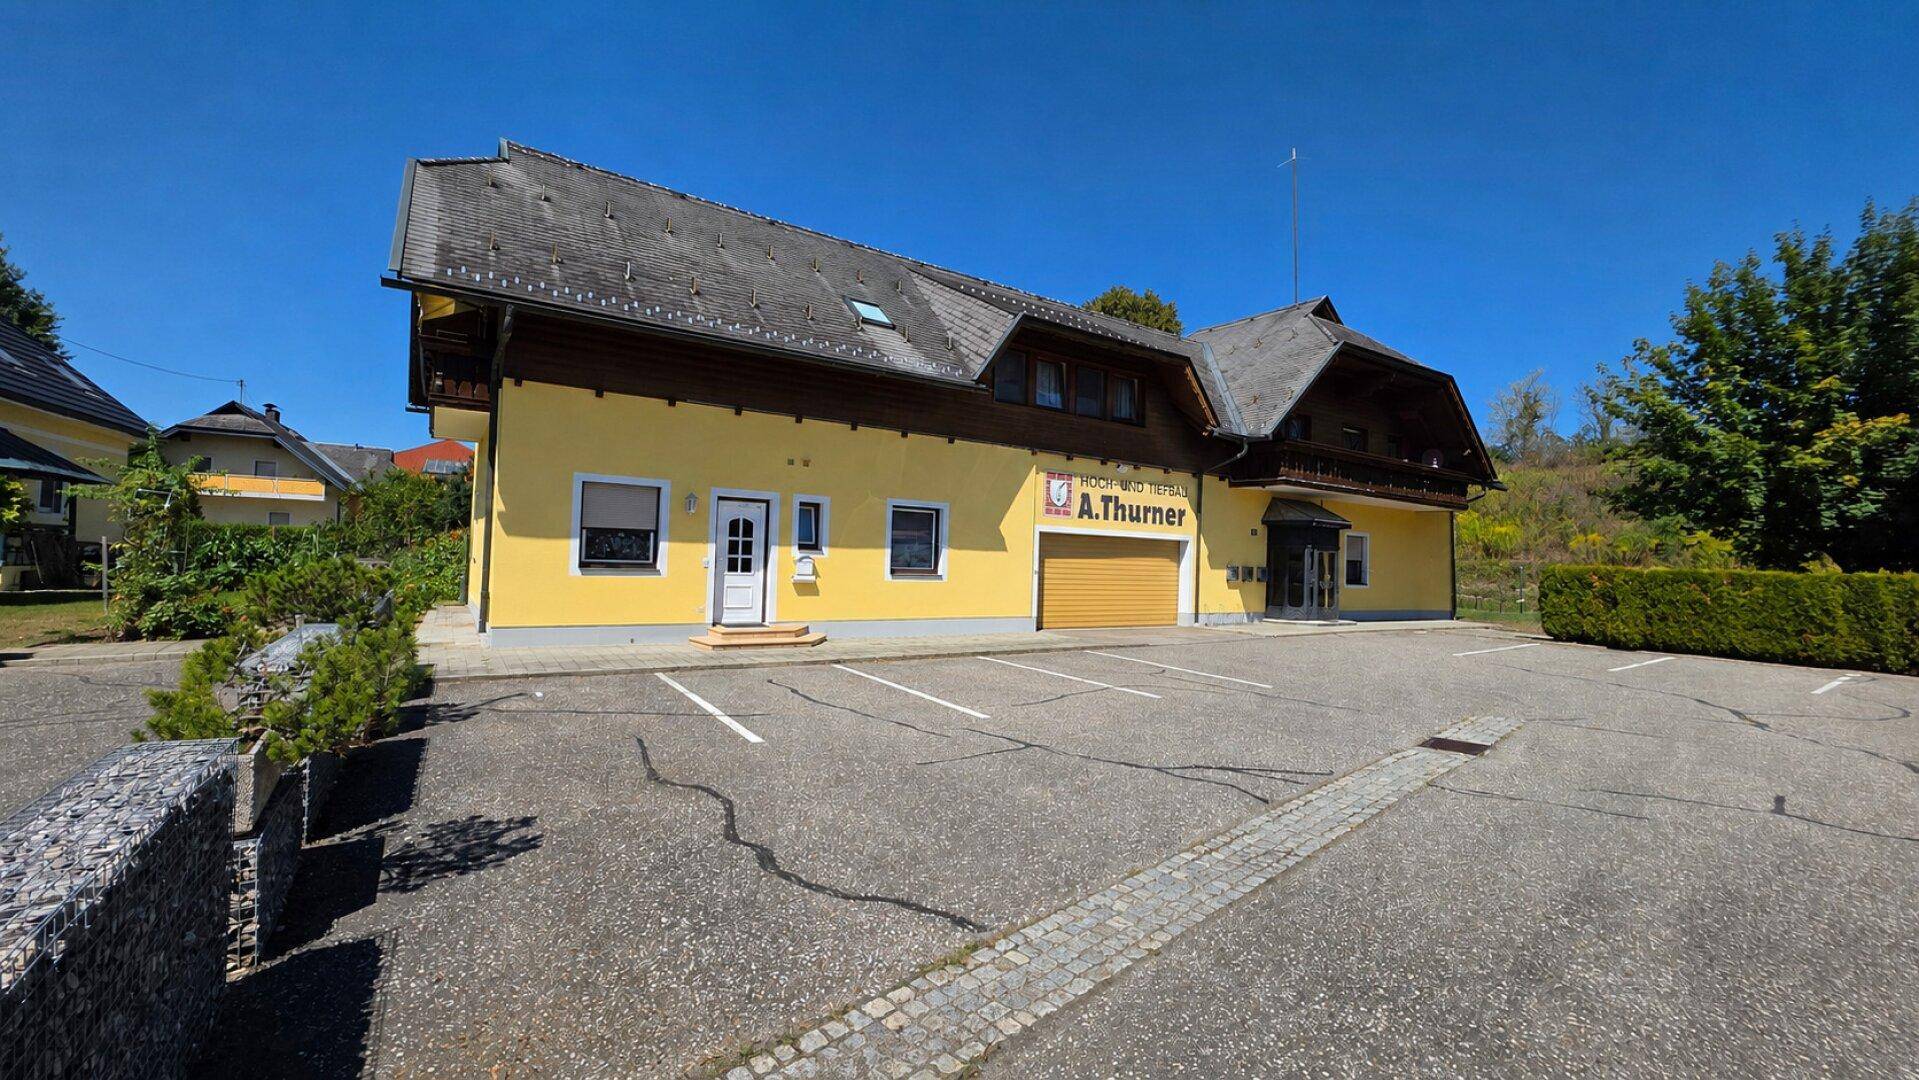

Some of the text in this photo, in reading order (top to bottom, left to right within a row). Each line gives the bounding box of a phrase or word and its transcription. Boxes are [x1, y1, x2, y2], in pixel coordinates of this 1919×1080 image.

[1080, 474, 1188, 498] HOCH- UND TIEFBAU
[1077, 492, 1187, 526] A.Thurner
